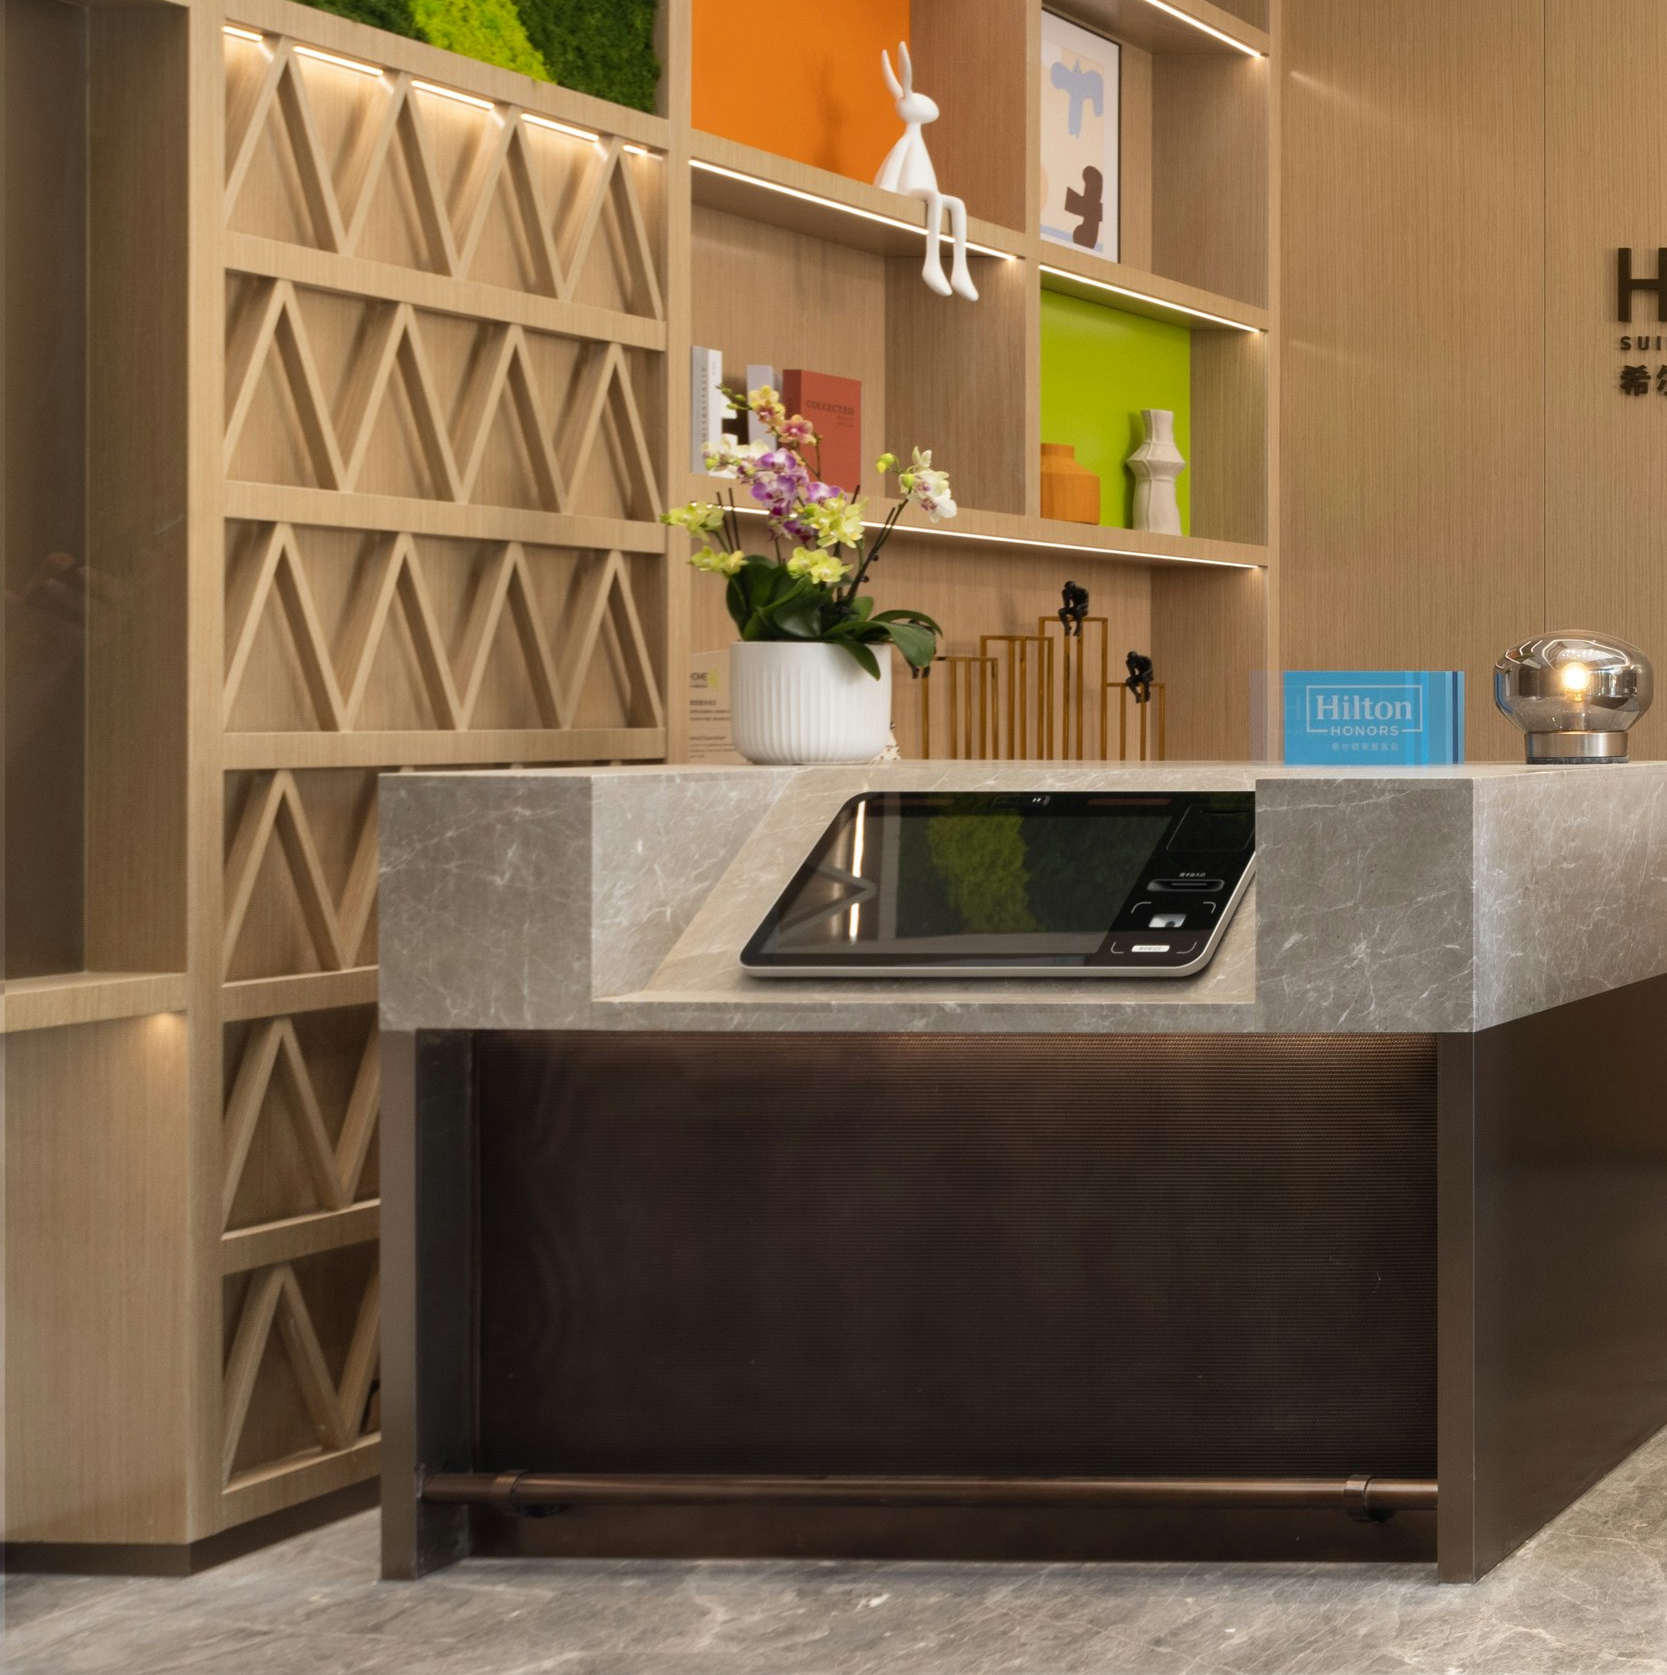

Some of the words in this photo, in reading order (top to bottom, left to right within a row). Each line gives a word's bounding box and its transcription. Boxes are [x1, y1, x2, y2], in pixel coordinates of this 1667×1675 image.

[806, 399, 855, 416] COLLECTED
[1315, 694, 1413, 721] Hilton
[1330, 725, 1400, 737] HONORS
